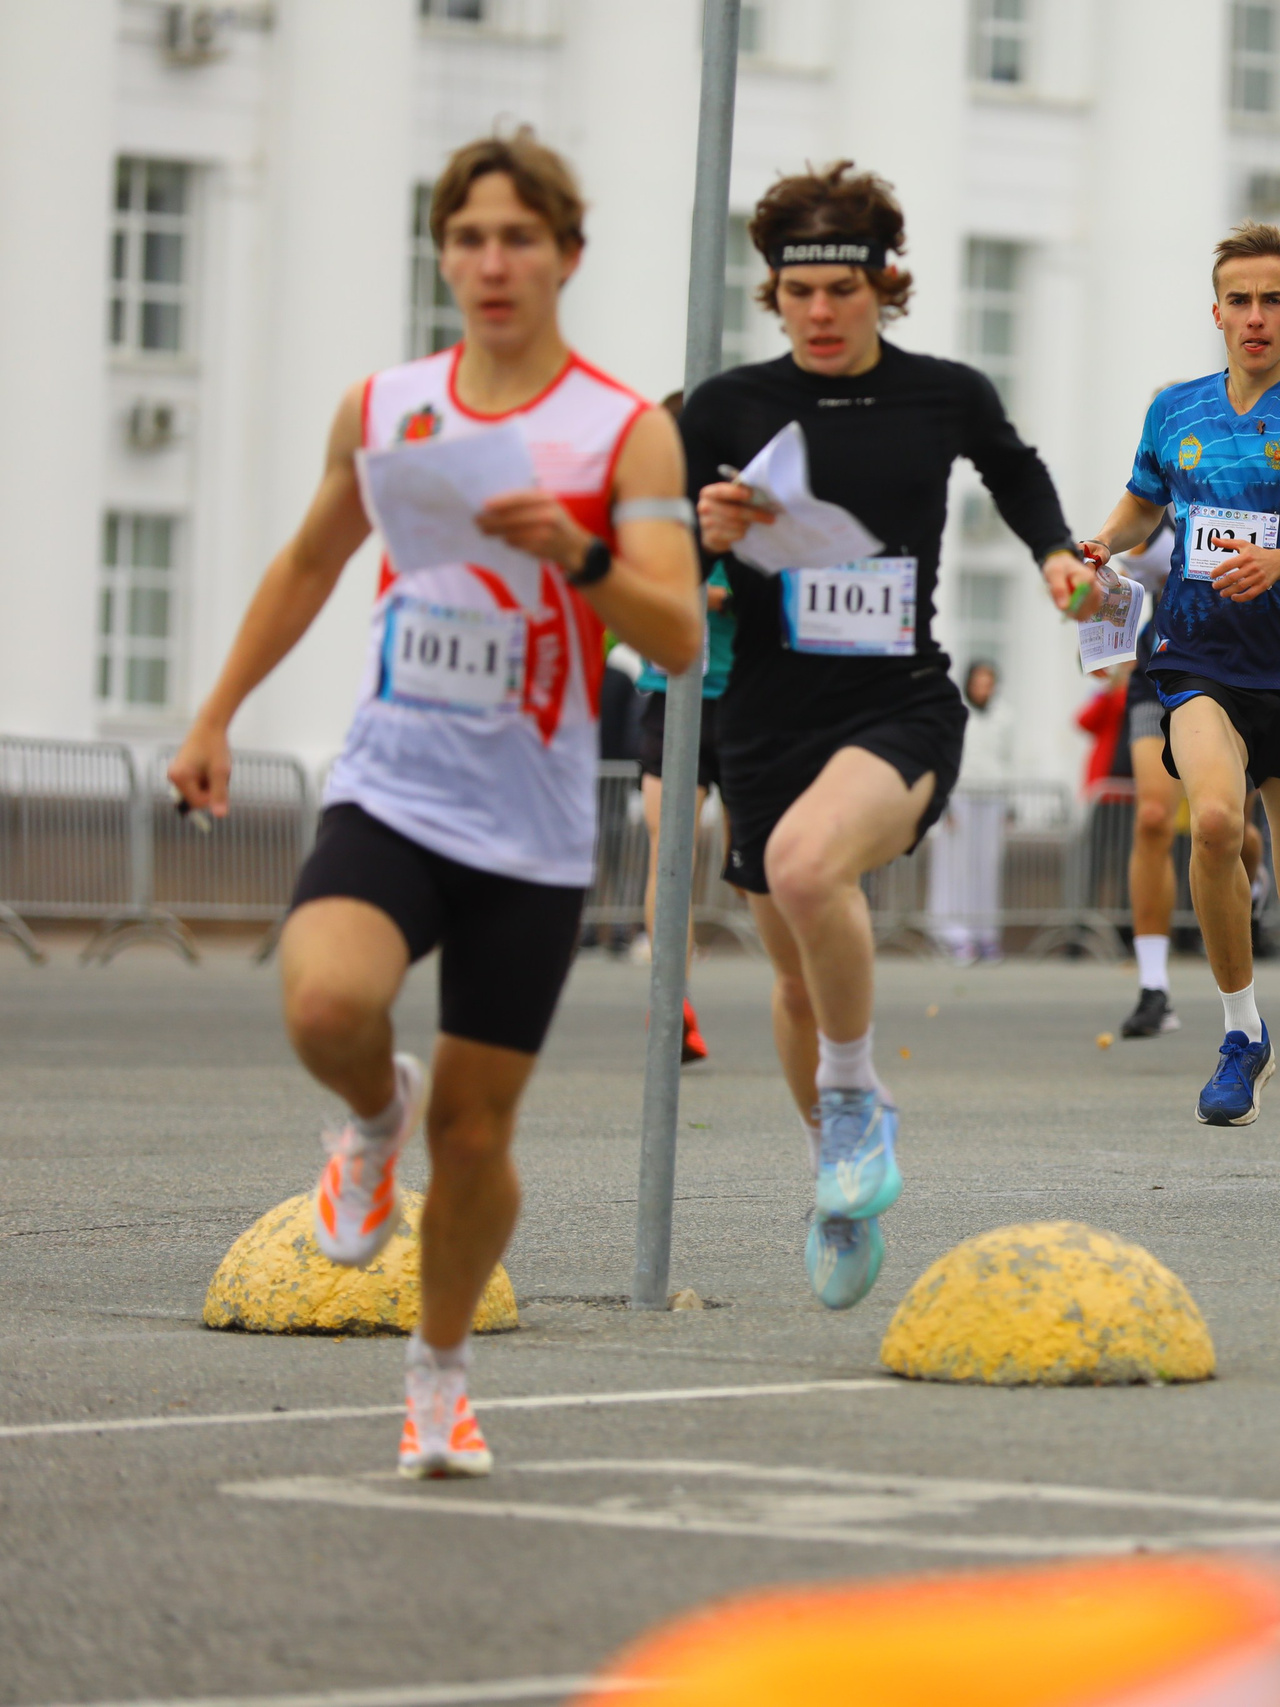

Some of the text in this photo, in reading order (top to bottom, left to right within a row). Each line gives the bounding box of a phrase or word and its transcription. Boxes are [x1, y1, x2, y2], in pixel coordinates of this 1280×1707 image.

[782, 243, 870, 263] noname
[807, 581, 891, 615] 110.1
[402, 626, 498, 676] 101.1
